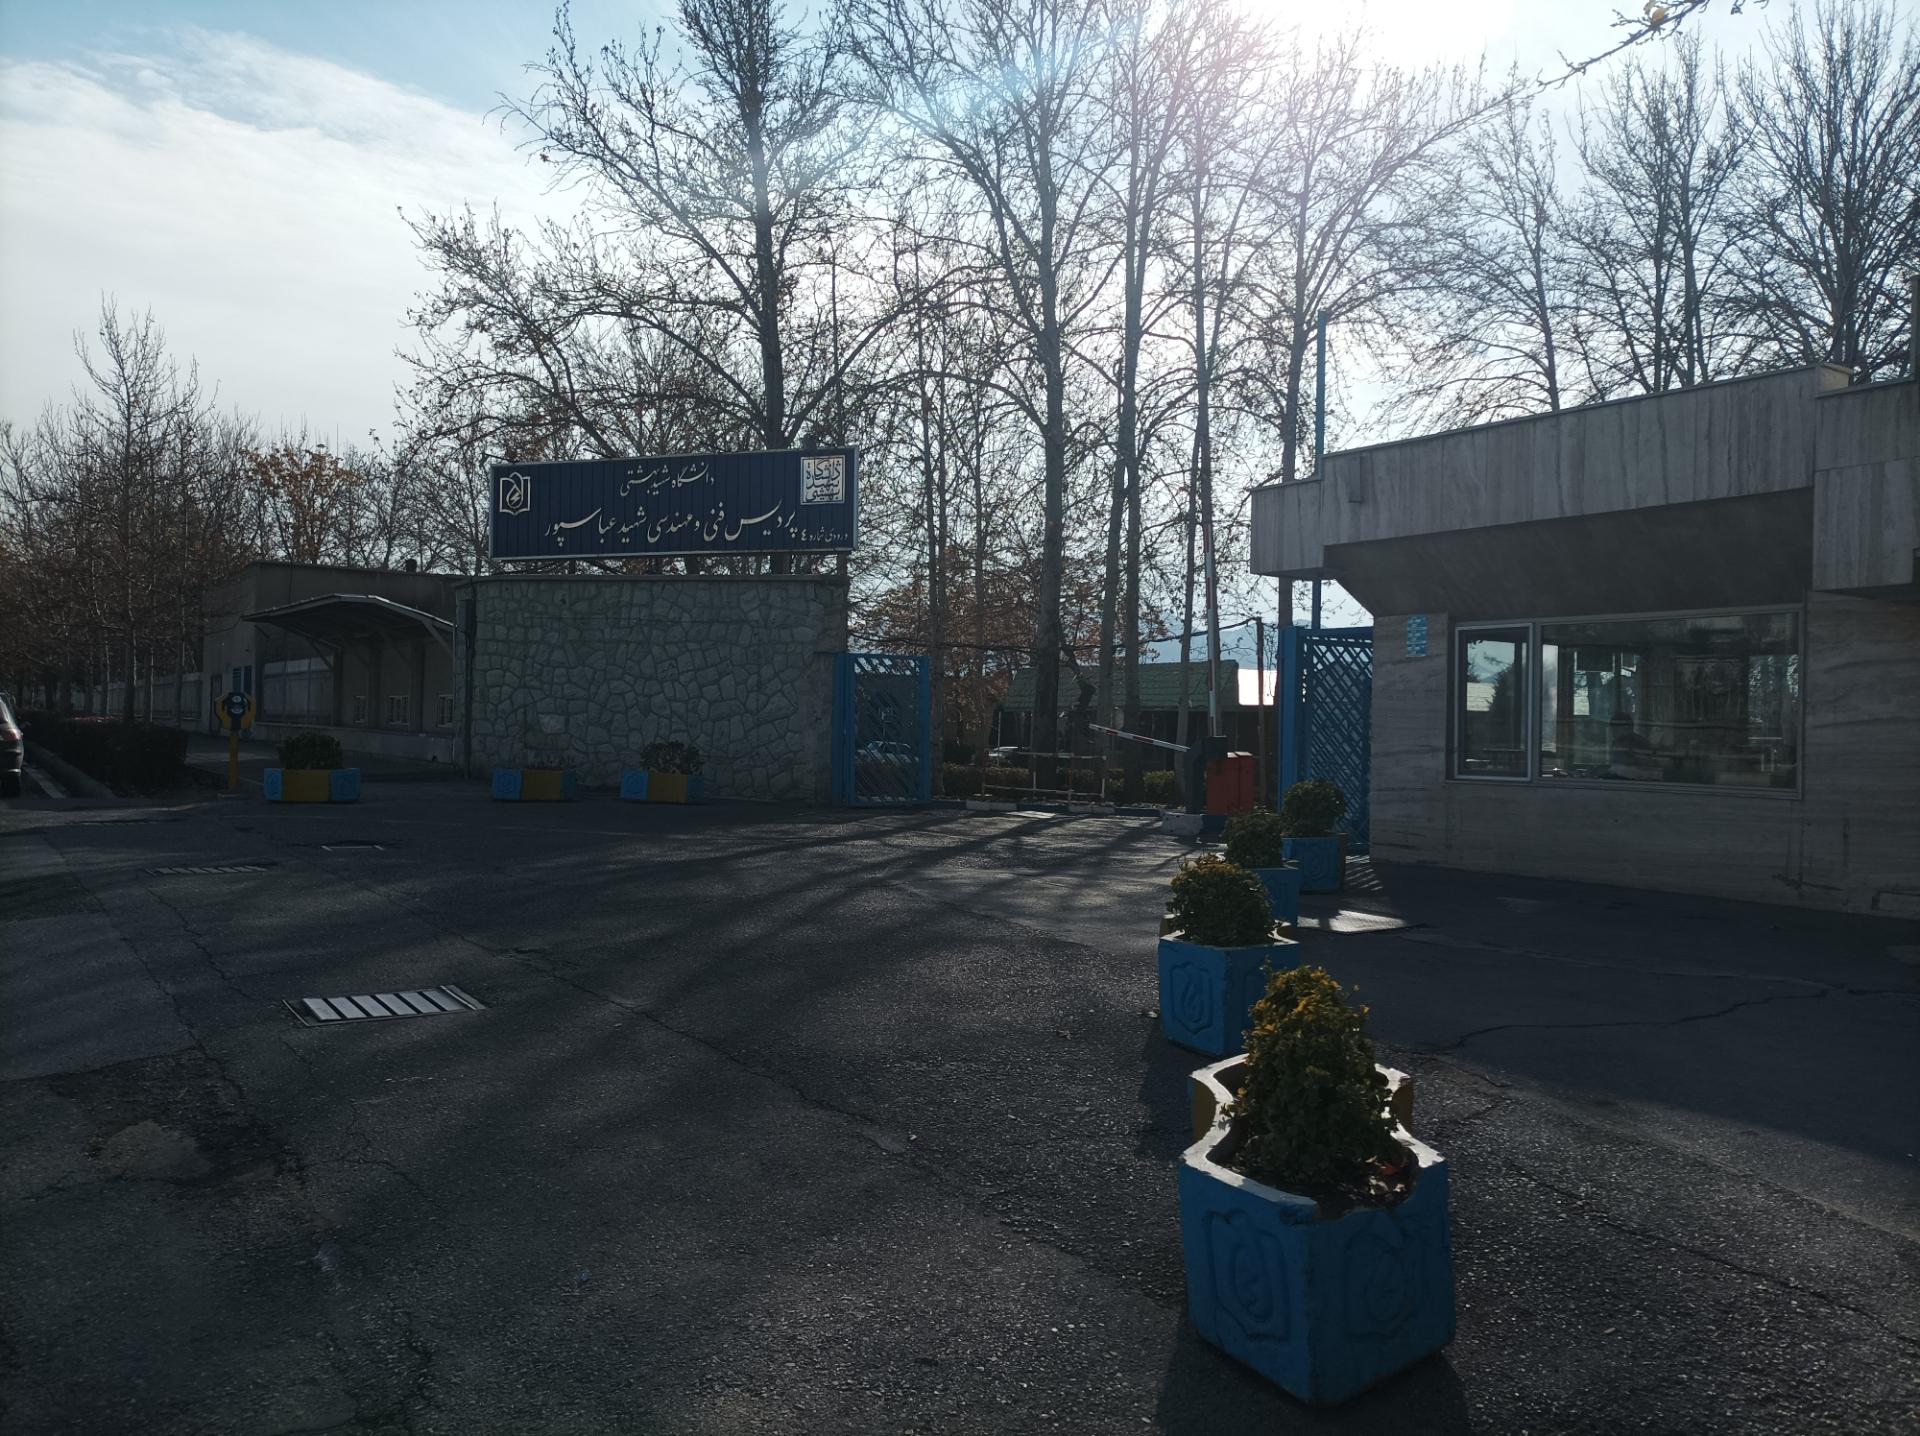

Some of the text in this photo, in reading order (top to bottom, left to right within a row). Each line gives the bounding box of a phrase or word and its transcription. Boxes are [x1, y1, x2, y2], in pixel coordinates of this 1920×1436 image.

[620, 461, 714, 497] دانشگاه شهید بهشتی
[617, 506, 647, 543] شهید
[647, 511, 693, 543] مهندسی
[693, 520, 700, 532] و
[703, 502, 725, 542] فنی
[724, 498, 799, 542] پردیس
